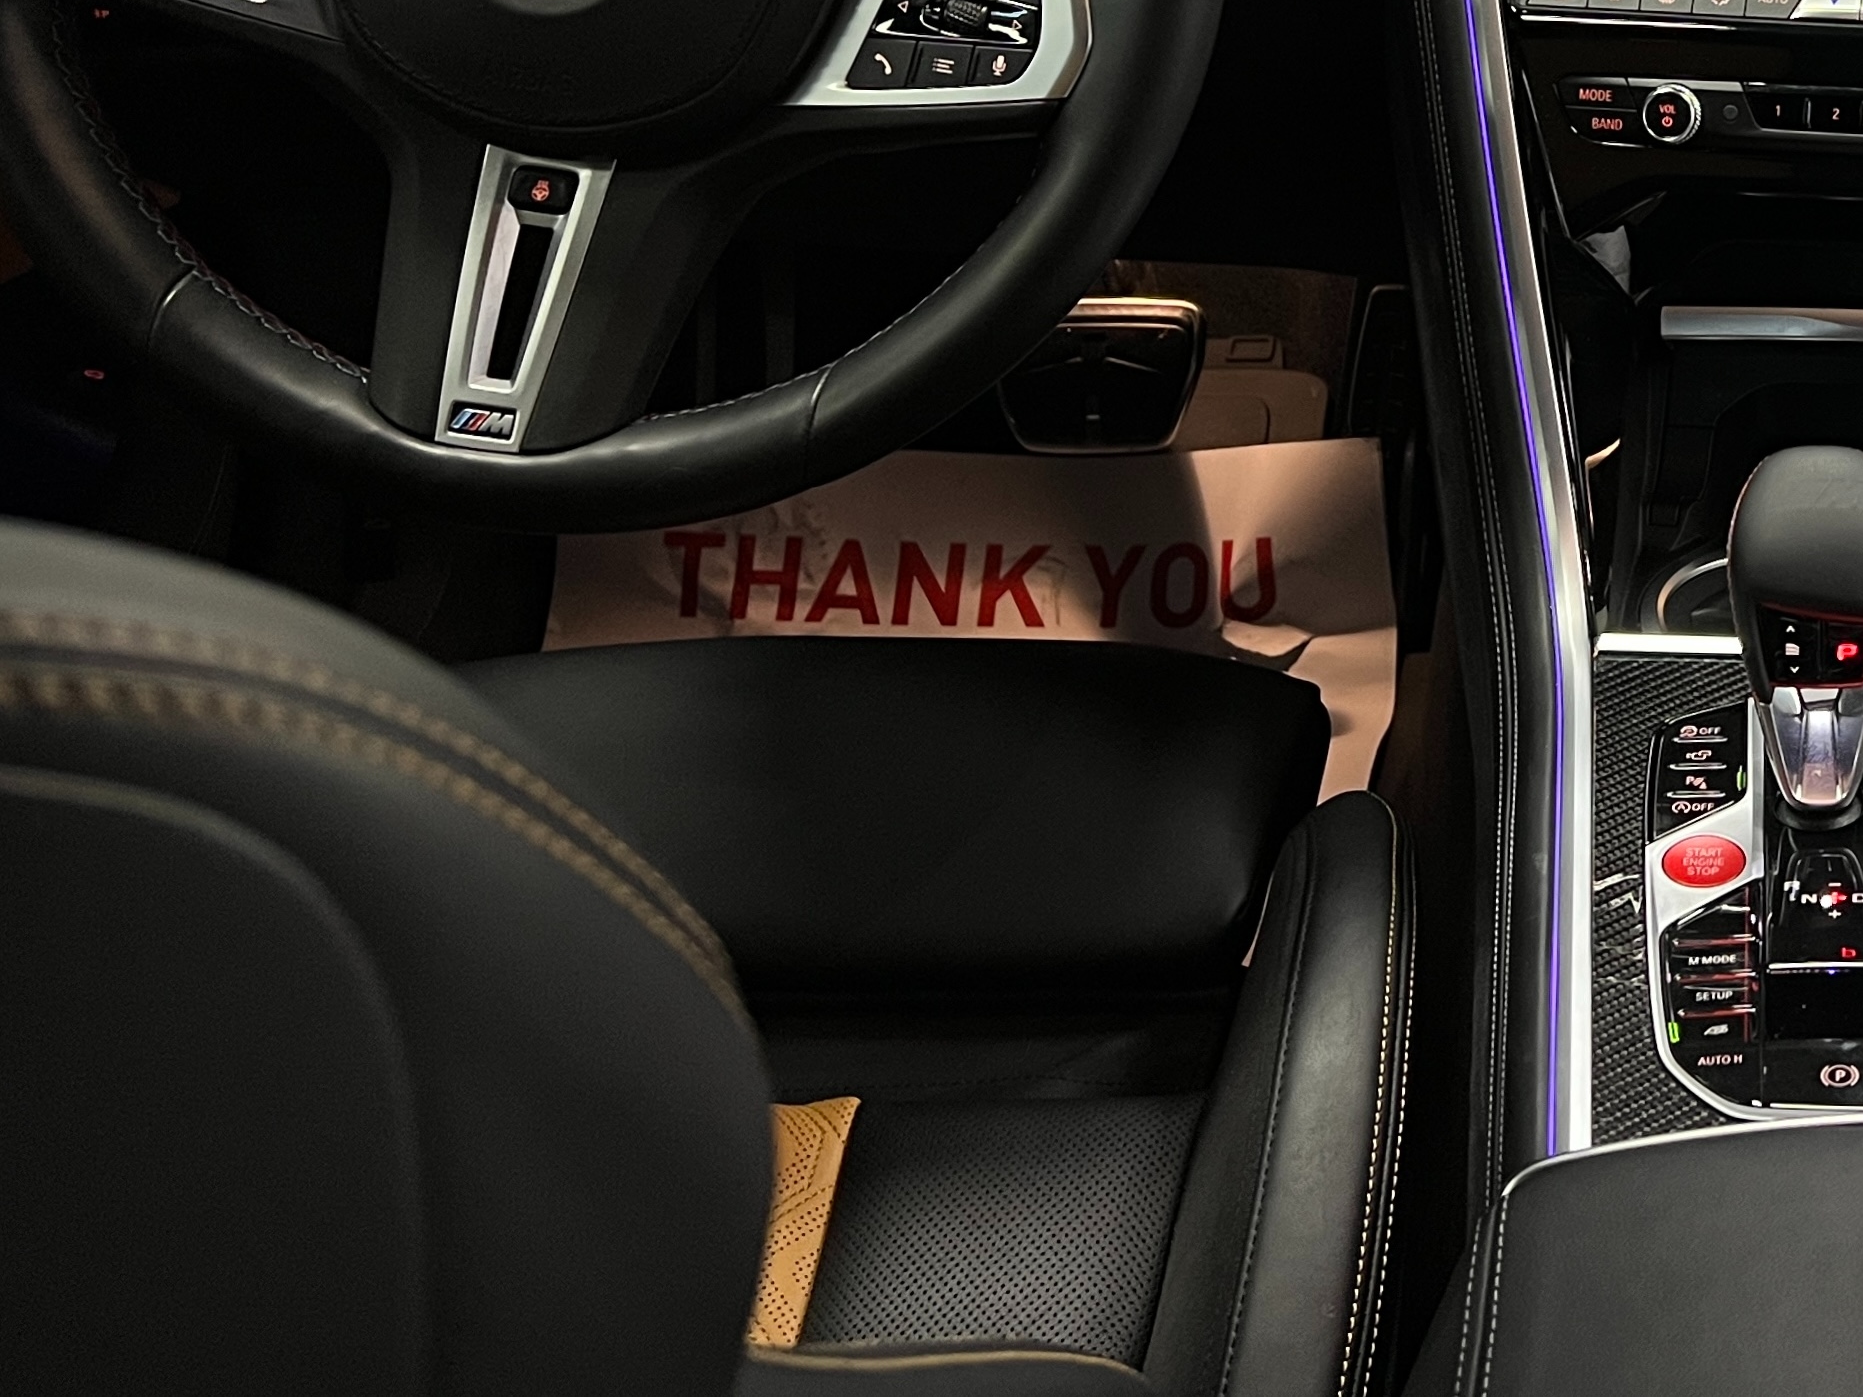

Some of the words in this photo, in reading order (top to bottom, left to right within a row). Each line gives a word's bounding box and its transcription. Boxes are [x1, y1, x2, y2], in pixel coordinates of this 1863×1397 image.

[1579, 89, 1613, 102] MODE
[1659, 105, 1677, 114] VOL
[1775, 105, 1781, 117] 1
[1832, 108, 1840, 120] 2
[1591, 117, 1623, 130] BAND
[663, 531, 1051, 627] THANK
[1083, 535, 1278, 629] YOU
[1837, 643, 1858, 661] P
[1699, 726, 1721, 735] OFF
[1692, 803, 1715, 812] OFF
[1685, 847, 1723, 858] START
[1683, 857, 1724, 867] ENGINE
[1687, 866, 1720, 876] STOP
[1801, 893, 1817, 904] N
[1688, 956, 1700, 965] M
[1702, 954, 1737, 965] MODE
[1696, 990, 1733, 1002] SETUP
[1698, 1056, 1731, 1066] AUTO
[1734, 1054, 1743, 1064] H
